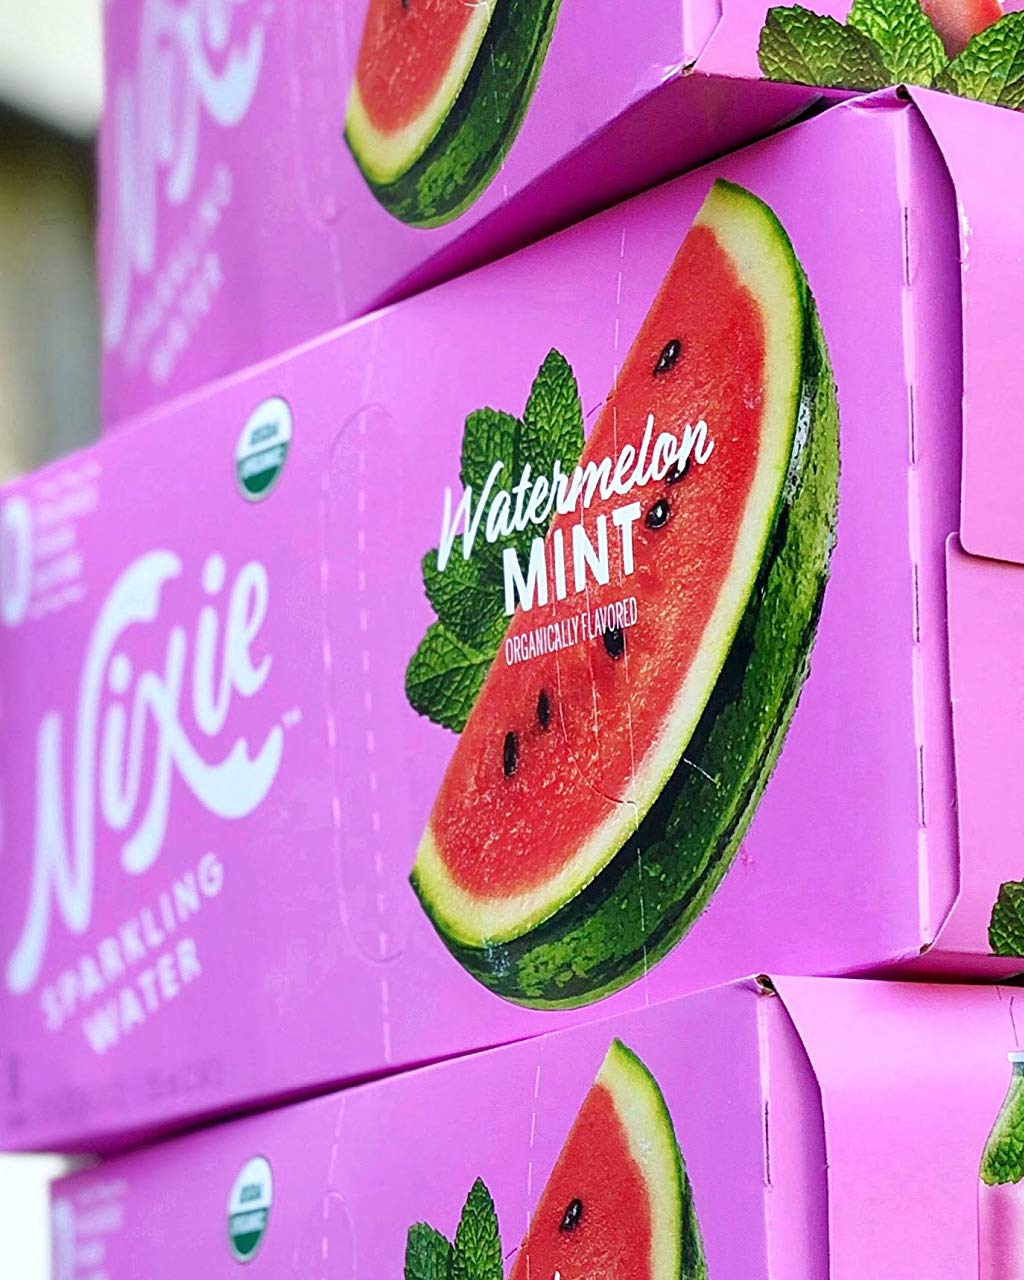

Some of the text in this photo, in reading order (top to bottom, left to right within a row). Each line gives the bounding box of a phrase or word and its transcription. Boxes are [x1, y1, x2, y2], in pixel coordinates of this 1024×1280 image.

[436, 413, 715, 572] Watermelon
[502, 501, 641, 616] MINT
[505, 596, 638, 665] ORGANICALLY FLAVORED
[5, 549, 285, 997] Nixie
